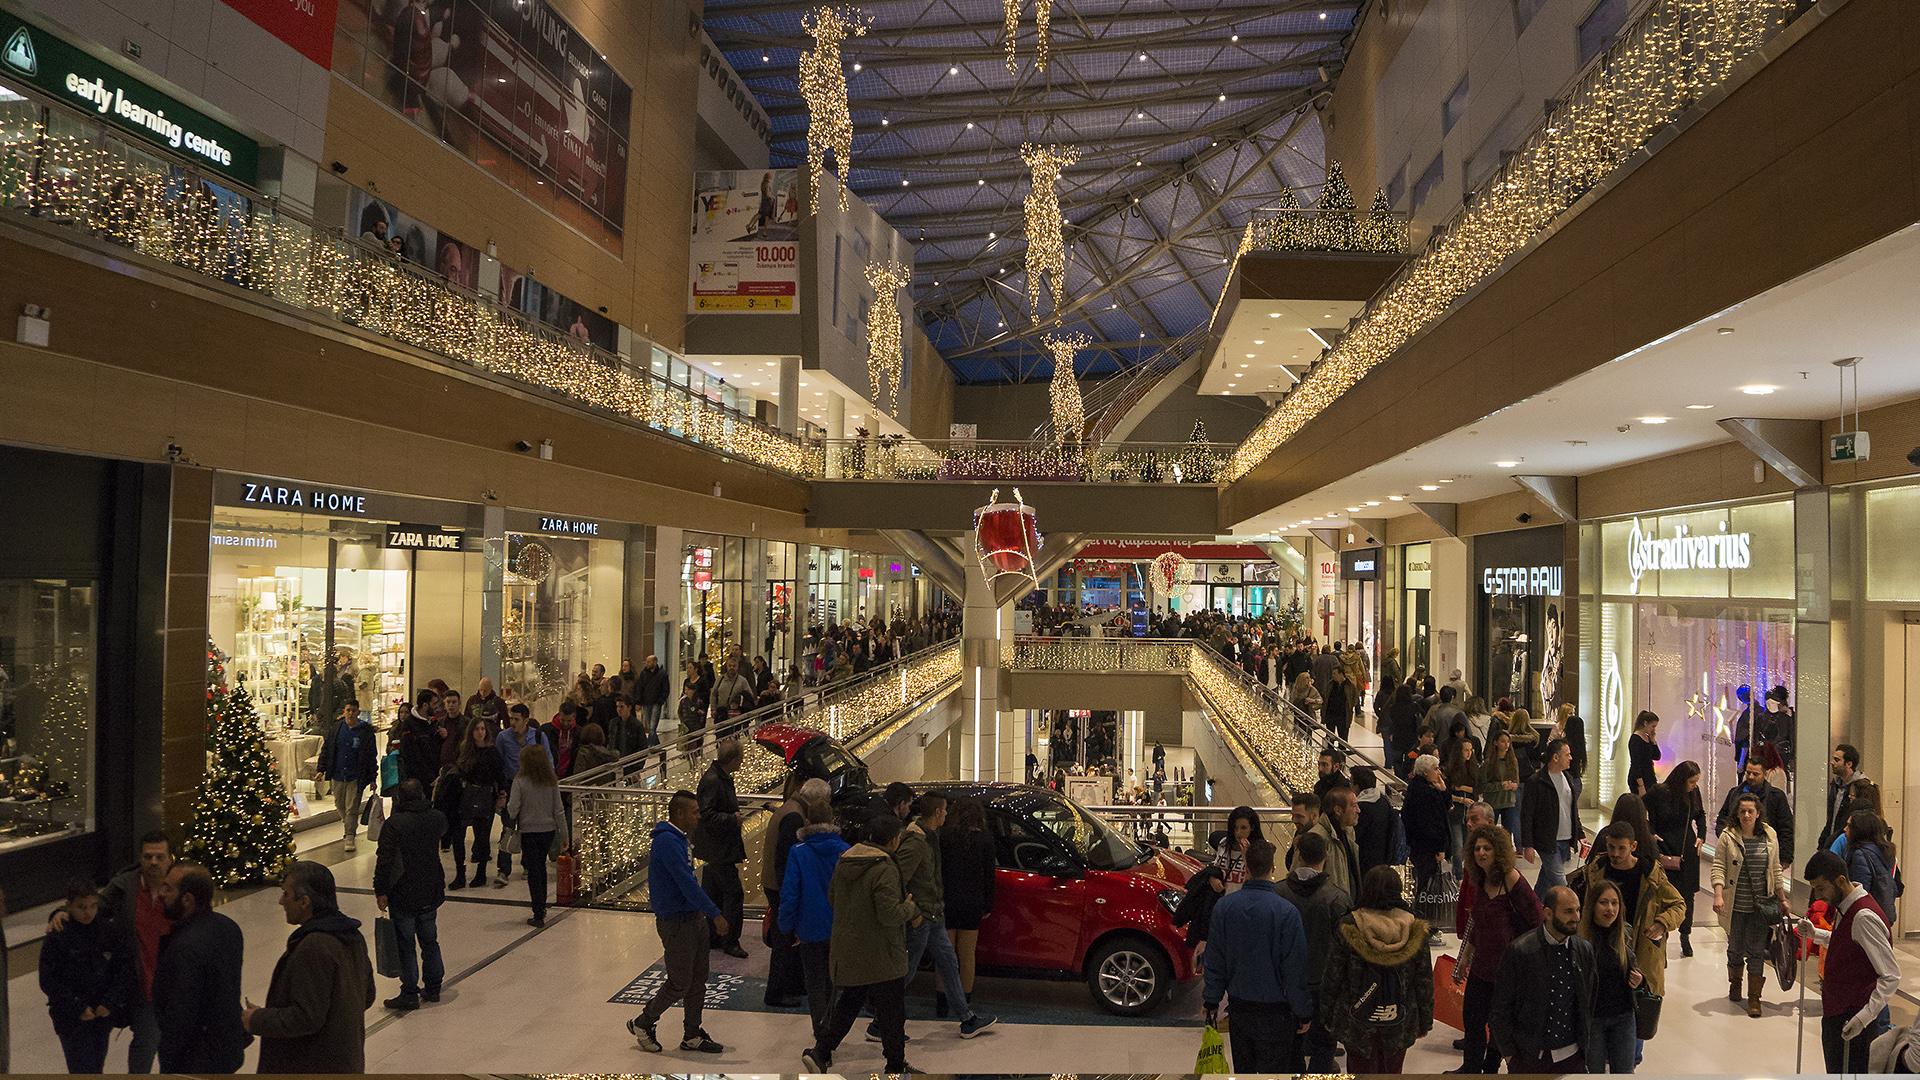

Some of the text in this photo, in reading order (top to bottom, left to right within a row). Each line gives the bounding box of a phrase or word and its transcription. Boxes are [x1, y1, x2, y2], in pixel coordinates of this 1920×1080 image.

[65, 72, 232, 167] early learning centre
[755, 246, 795, 262] 10.000
[244, 483, 366, 514] ZARA HOME
[389, 532, 460, 549] ZARA HOME
[541, 517, 599, 536] ZARA HOME
[1635, 519, 1750, 571] stradivarius
[1483, 566, 1562, 597] G-STAR RAW
